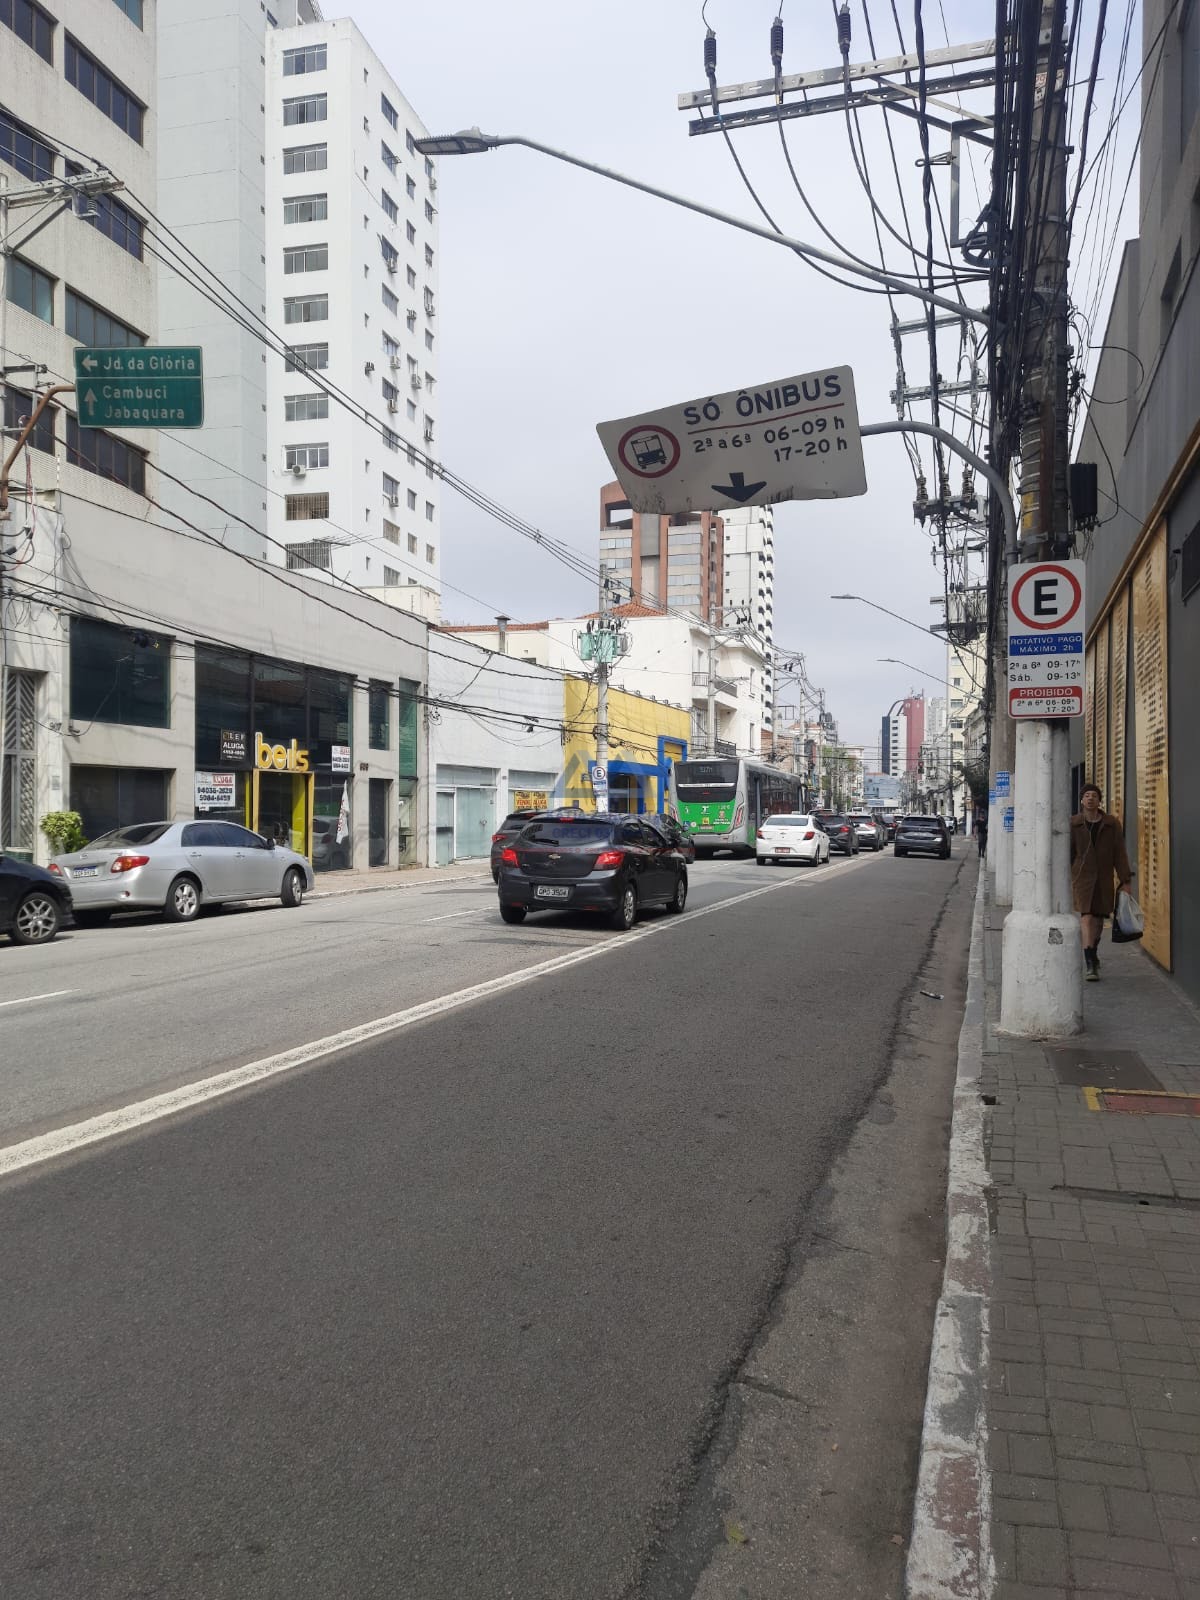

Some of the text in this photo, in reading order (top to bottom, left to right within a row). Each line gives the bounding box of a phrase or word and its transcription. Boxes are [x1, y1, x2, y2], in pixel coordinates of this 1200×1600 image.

[127, 357, 144, 370] da
[149, 355, 195, 370] Glória
[102, 385, 168, 399] Cambuci
[684, 374, 842, 426] SÓ ÔNIBUS
[104, 405, 185, 421] Jabaquara
[763, 417, 827, 444] 06-09
[774, 438, 830, 462] 17-20
[1034, 578, 1058, 616] E
[1010, 635, 1082, 646] ROTATIVO PAGO
[1020, 645, 1057, 653] MÁXIMO
[1009, 674, 1033, 682] Sáb.
[1020, 687, 1073, 697] PROIBIDO
[222, 741, 245, 750] ALUGA
